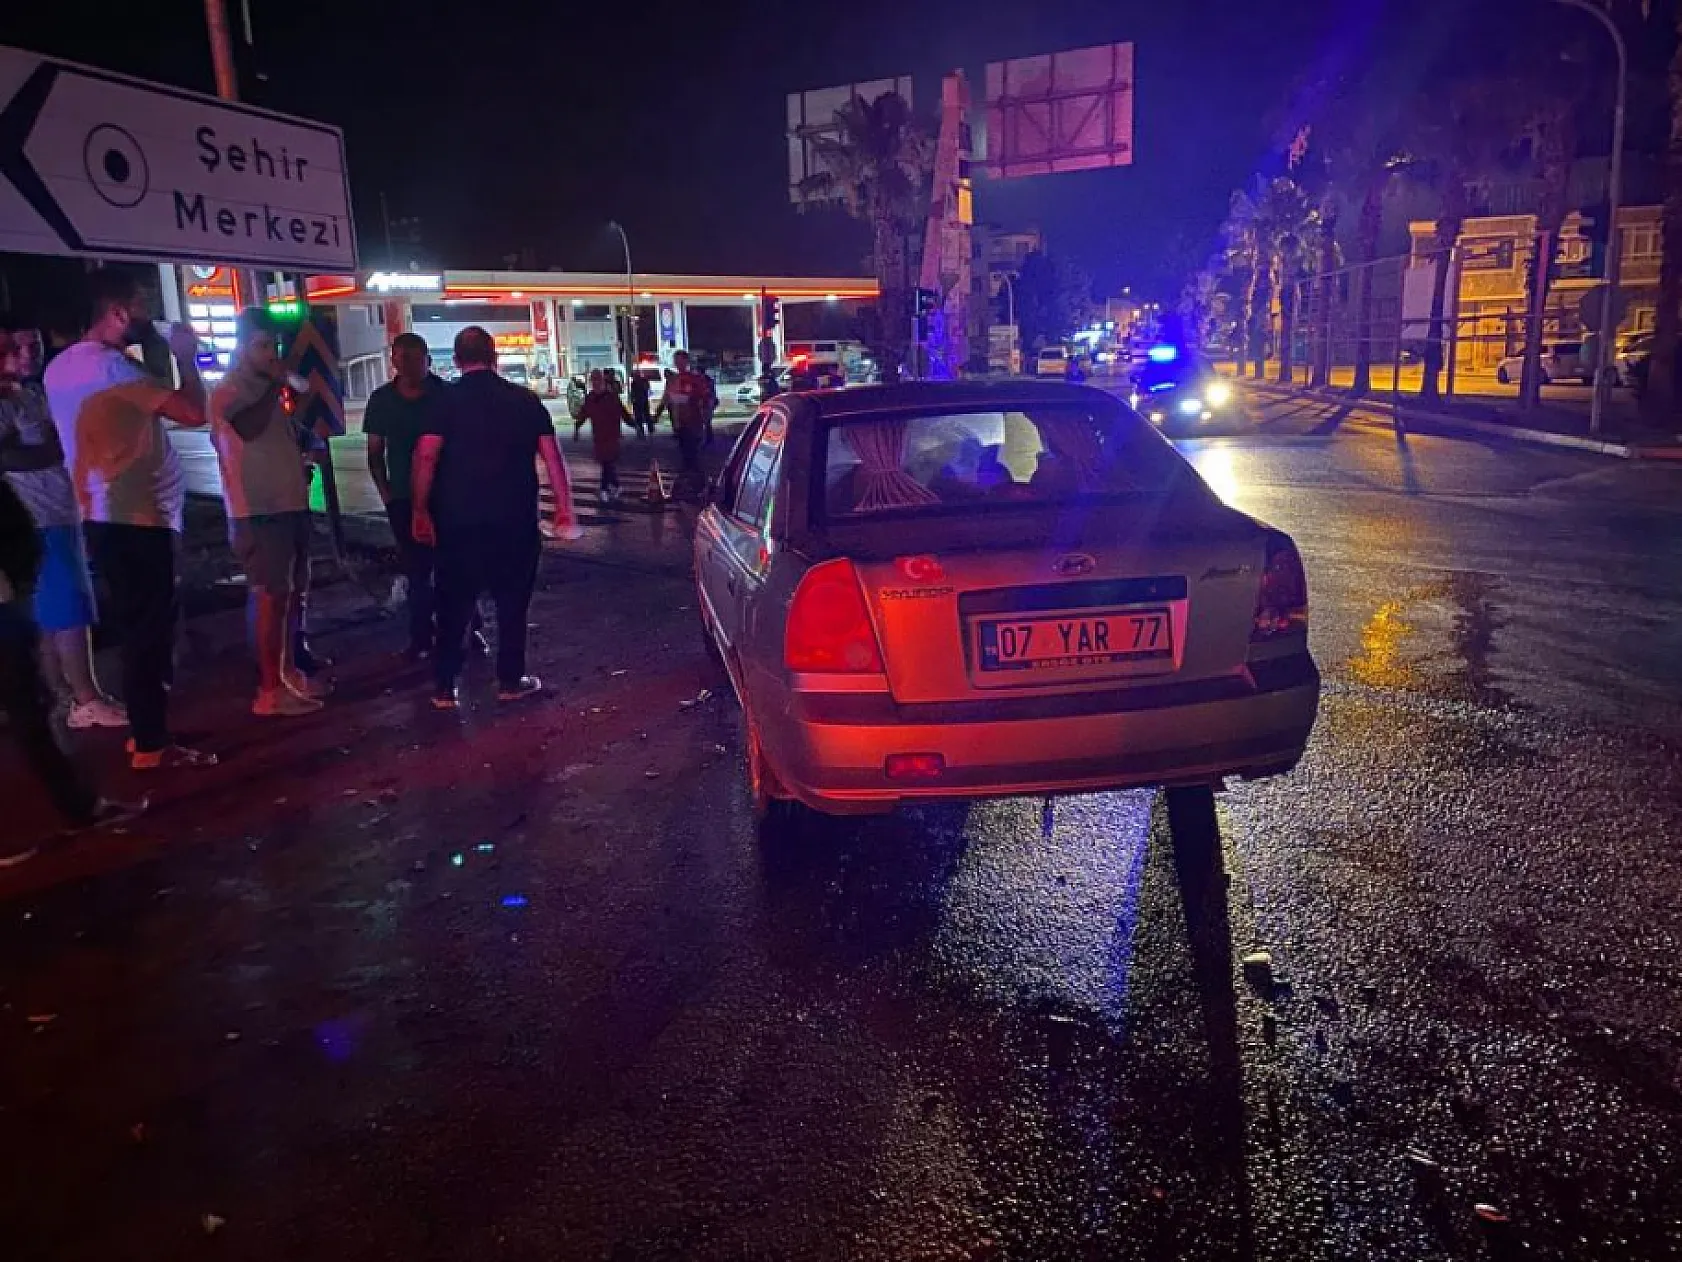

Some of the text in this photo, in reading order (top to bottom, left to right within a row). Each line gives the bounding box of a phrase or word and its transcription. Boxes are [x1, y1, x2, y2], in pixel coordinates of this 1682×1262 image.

[196, 126, 308, 182] Şehir
[173, 190, 339, 247] Merkezi
[1001, 617, 1163, 657] 07 YAR 77
